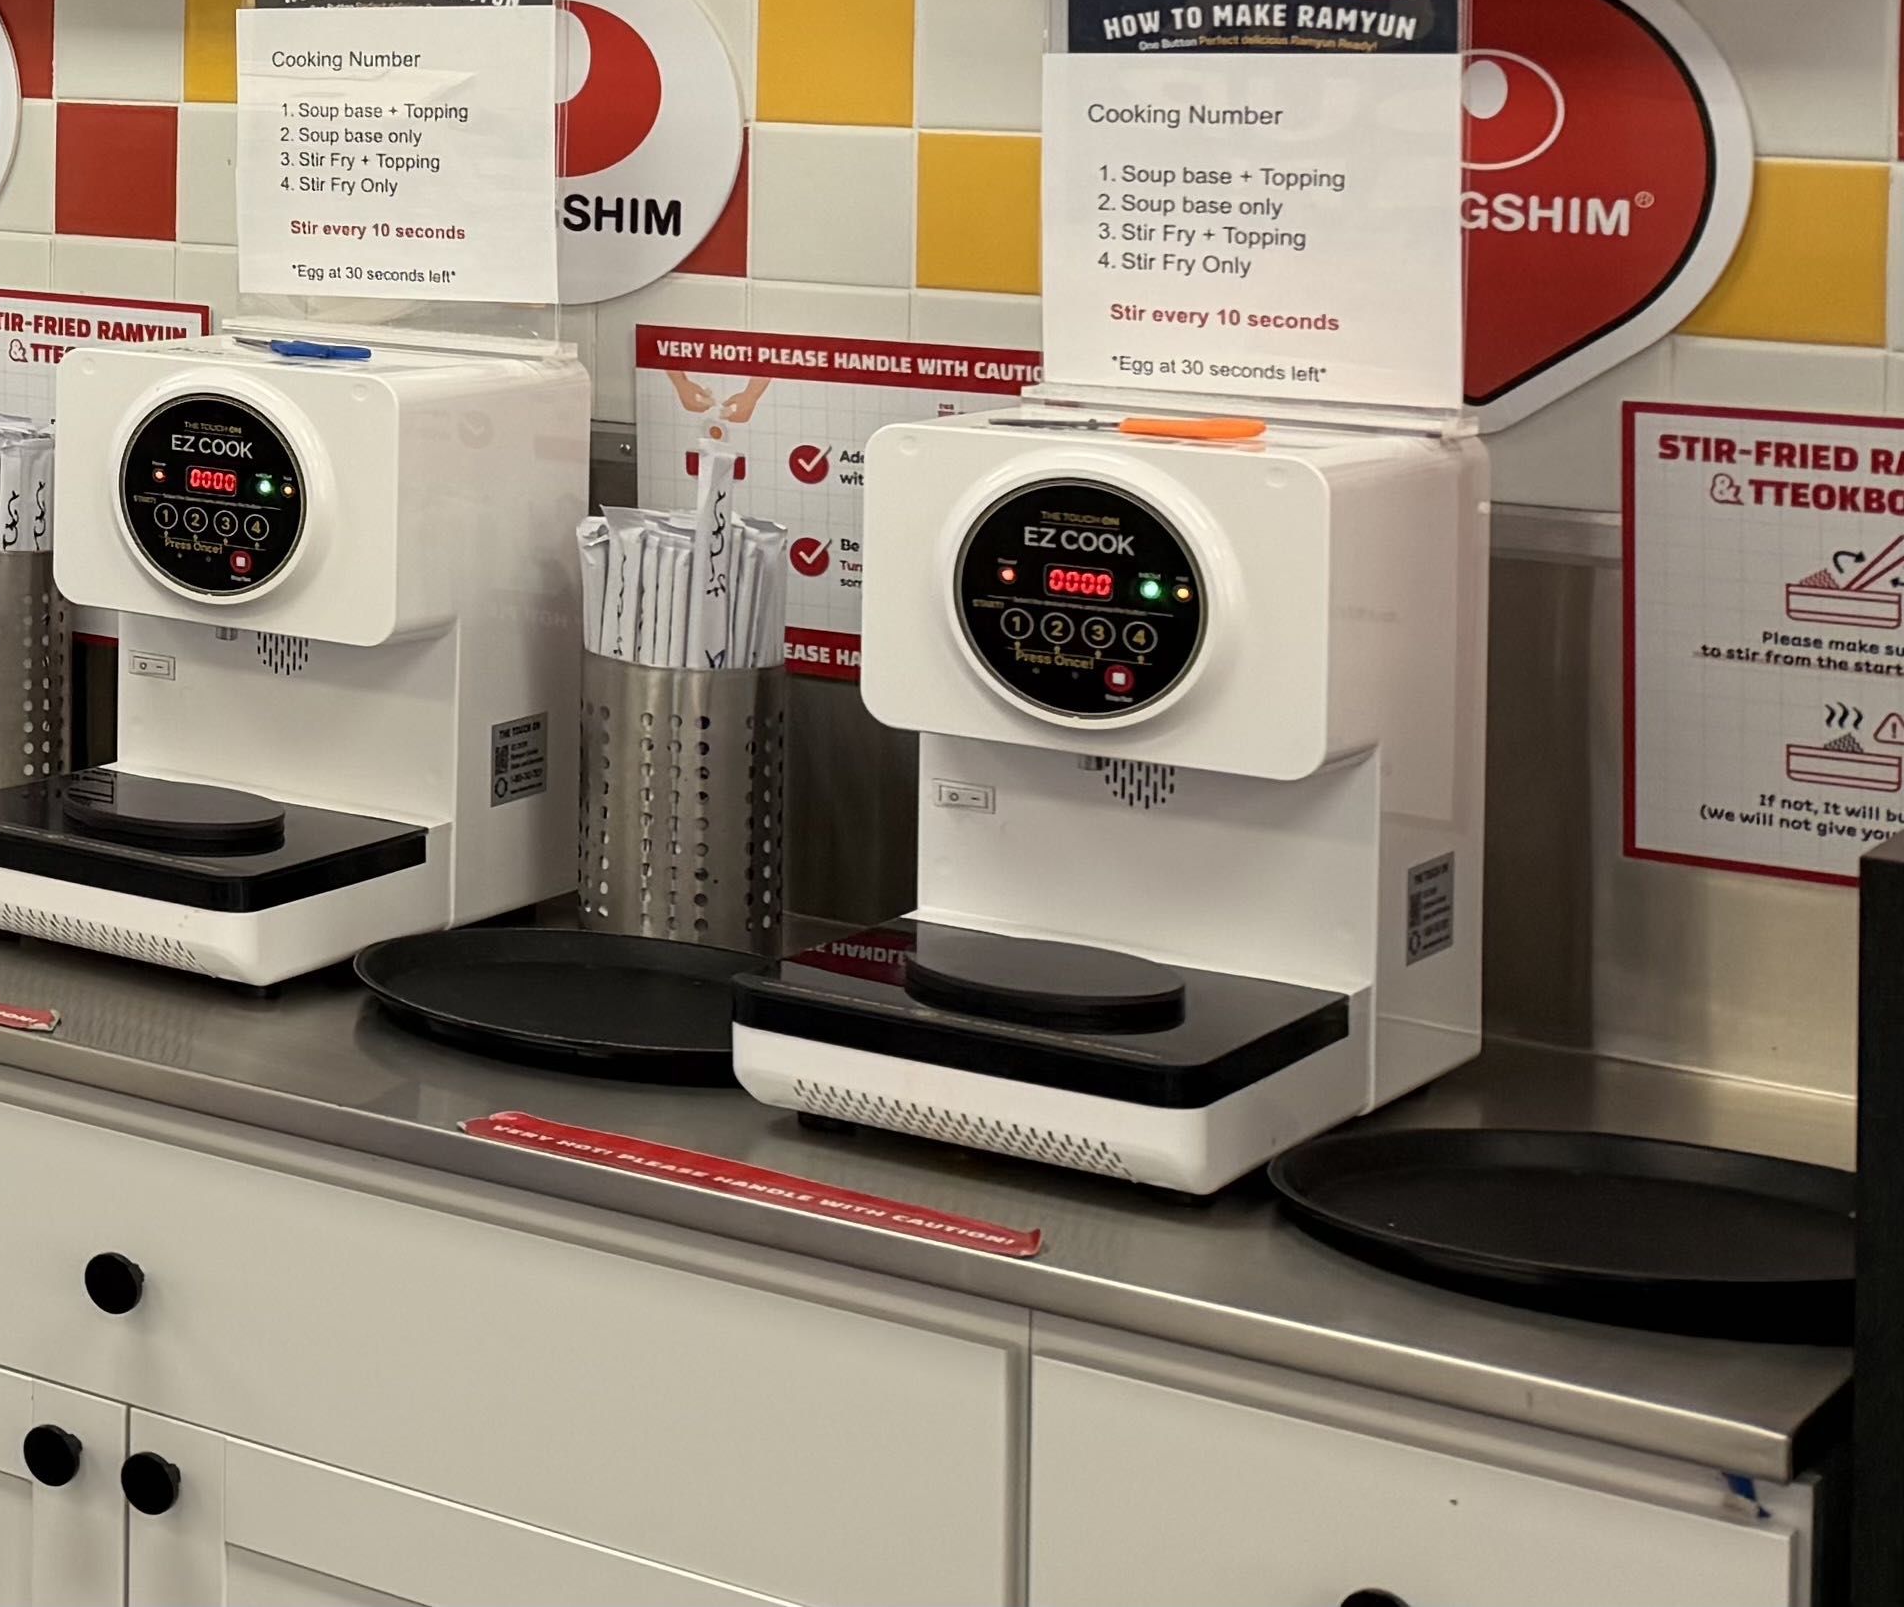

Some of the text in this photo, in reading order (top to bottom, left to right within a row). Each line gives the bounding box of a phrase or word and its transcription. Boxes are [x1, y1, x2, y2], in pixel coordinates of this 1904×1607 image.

[1103, 2, 1418, 41] HOW TO MAKE RAMYUN
[272, 51, 421, 72] Cooking Number
[282, 103, 468, 124] 1. Soup base + Topping
[1087, 104, 1283, 128] Cooking Number
[280, 127, 422, 149] 2. Soup base only
[281, 152, 440, 173] 3. Stir Fry + Topping
[281, 177, 398, 198] 4. Stir Fry Only
[1099, 166, 1347, 192] 1. Soup base + Topping
[1097, 195, 1283, 220] 2. Soup base only
[291, 221, 466, 240] Stir every 10 seconds
[1097, 223, 1307, 251] 3. Stir Fry + Topping
[328, 267, 342, 280] at
[346, 266, 363, 280] 30
[367, 267, 424, 283] seconds
[1097, 252, 1252, 279] 4. Stir Fry Only
[1110, 304, 1340, 332] Stir every 10 seconds
[657, 339, 704, 361] VERY
[709, 343, 752, 363] HOT!
[758, 346, 828, 369] PLEASE
[834, 352, 911, 374] HANDLE
[918, 357, 968, 379] WITH
[1160, 359, 1177, 375] at
[1181, 358, 1204, 376] 30
[1210, 359, 1286, 382] seconds
[171, 434, 253, 459] EZ COOK
[1658, 434, 1858, 473] STIR-FRIED
[1710, 473, 1744, 506] &
[1024, 526, 1135, 557] EZ COOK
[1762, 630, 1880, 655] Please make
[1702, 644, 1849, 672] to stir from the
[1759, 794, 1881, 821] If not, It will
[1700, 804, 1856, 838] (We will not give
